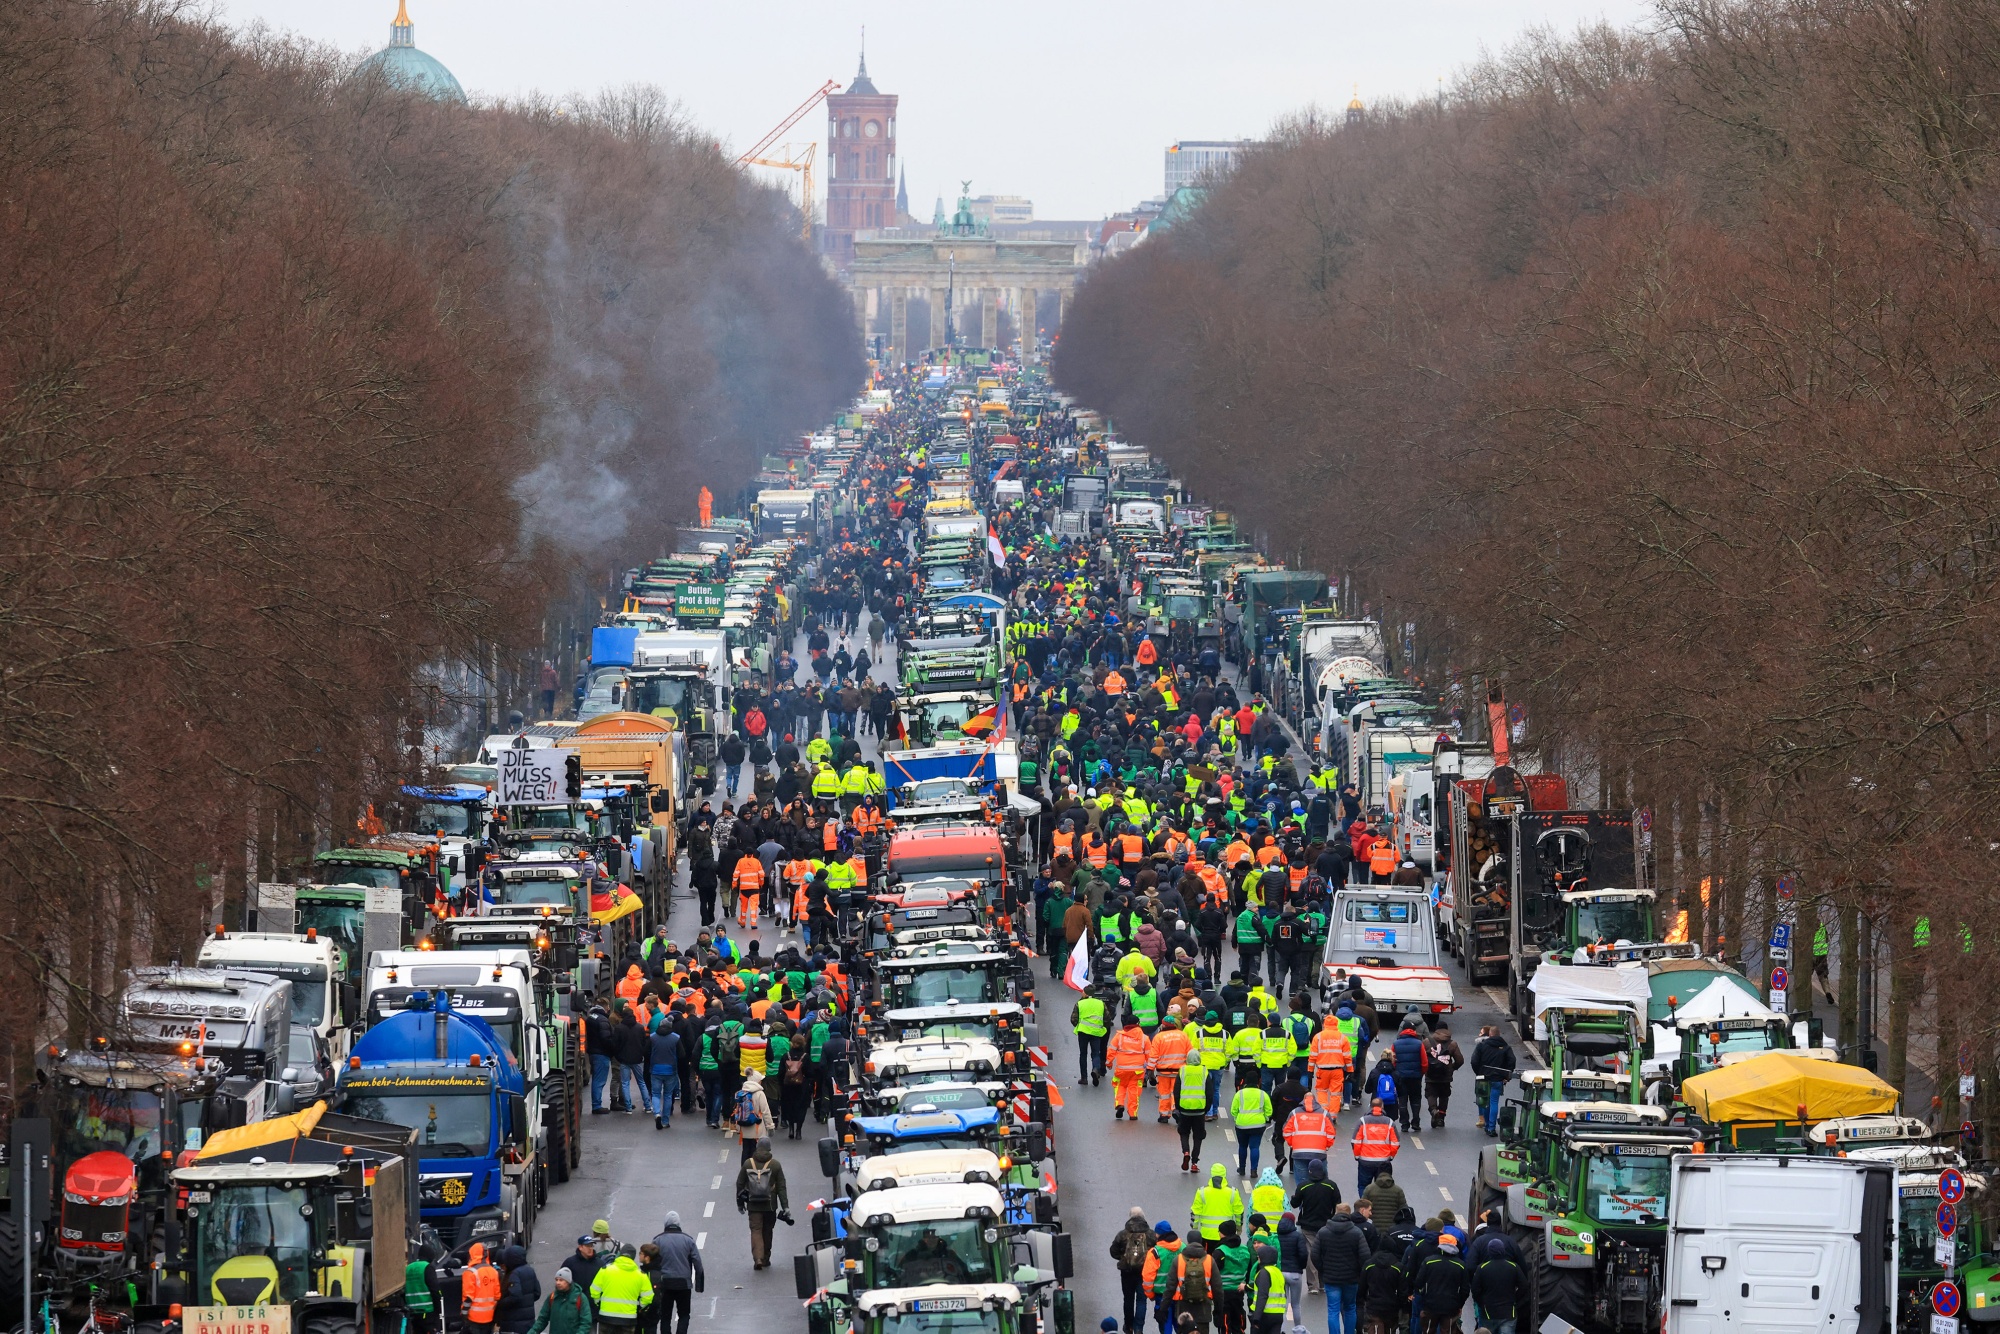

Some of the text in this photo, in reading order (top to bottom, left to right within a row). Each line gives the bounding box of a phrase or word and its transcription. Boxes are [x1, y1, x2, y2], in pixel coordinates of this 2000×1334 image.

[679, 596, 721, 605] Brot & Bier
[928, 669, 976, 678] AGRARSERVICE-MV
[503, 749, 535, 767] DIE
[503, 767, 552, 783] MUSS
[504, 781, 557, 802] WEG!!
[160, 1024, 217, 1041] McHae
[1571, 1080, 1581, 1088] WB
[925, 1093, 962, 1104] FENDT
[1859, 1128, 1868, 1136] UE
[1619, 1146, 1629, 1154] WB
[1902, 1188, 1913, 1196] UE
[1581, 1233, 1592, 1241] 40
[919, 1300, 965, 1310] WHV SJ 724
[238, 1308, 266, 1319] DER
